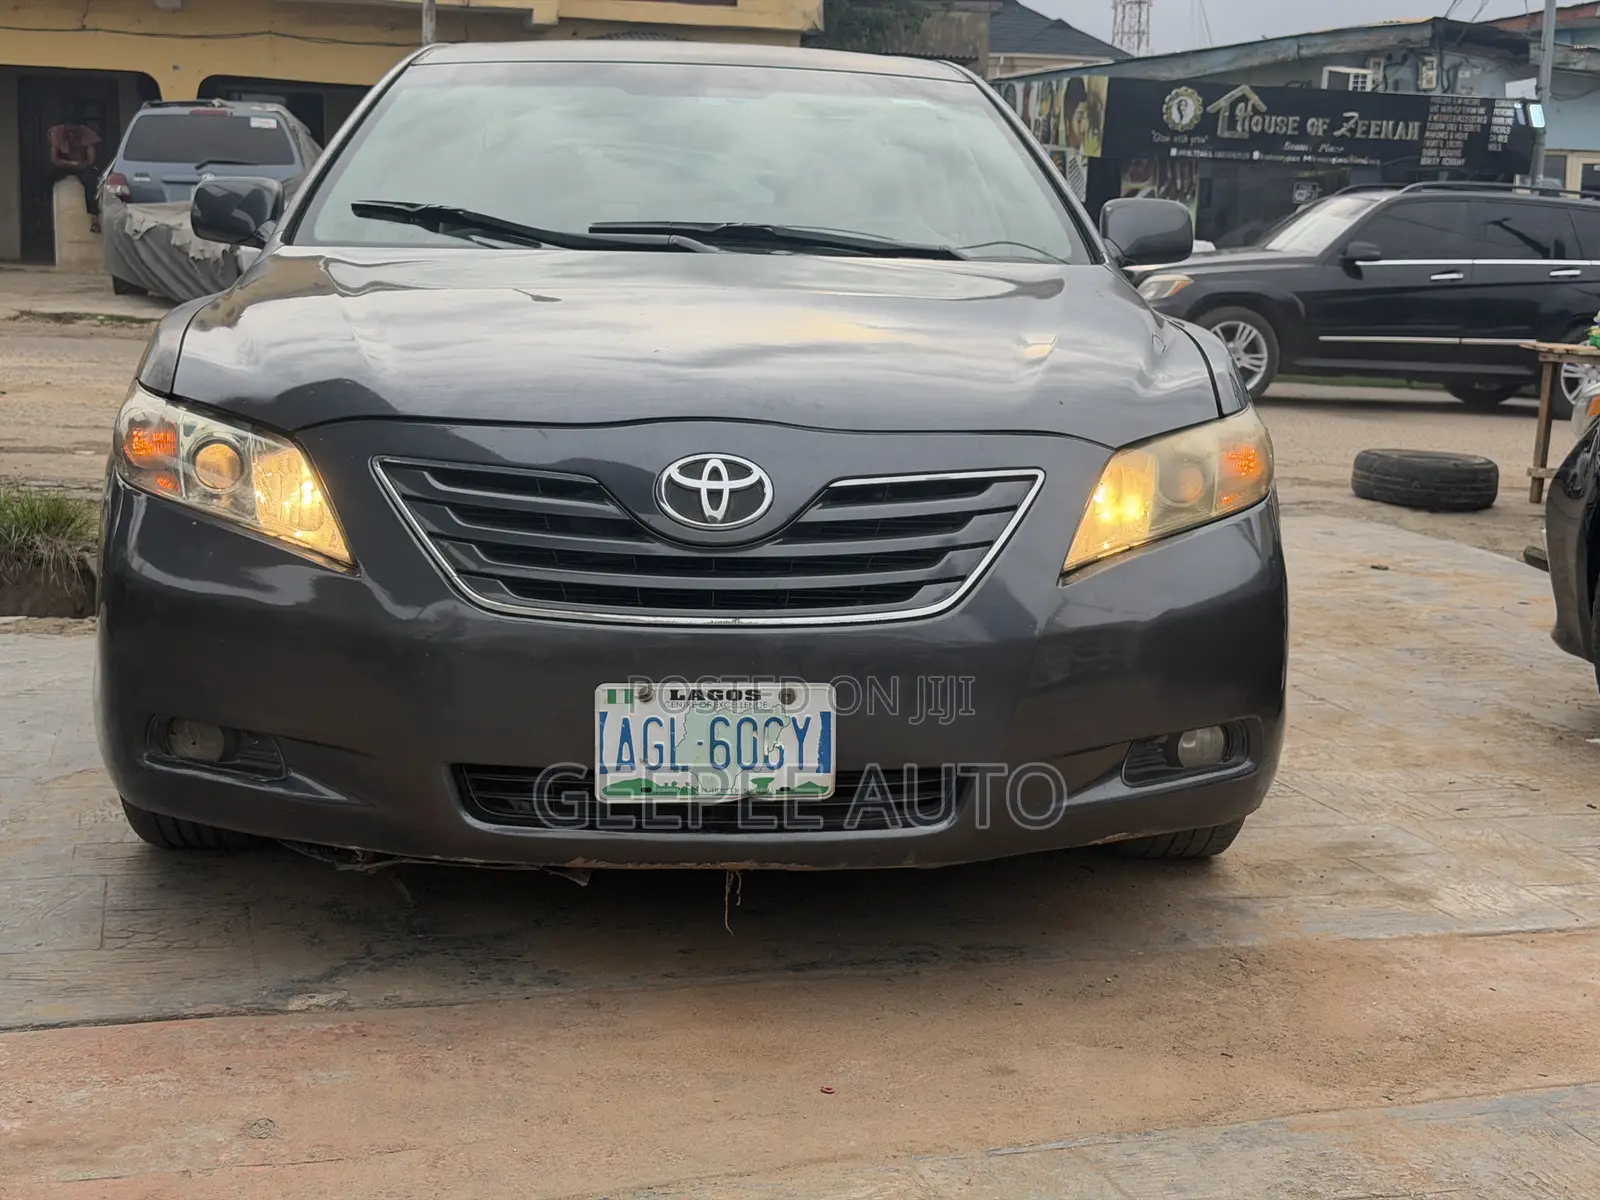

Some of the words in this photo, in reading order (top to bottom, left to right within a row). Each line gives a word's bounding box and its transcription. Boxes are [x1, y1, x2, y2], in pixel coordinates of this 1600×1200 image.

[1236, 102, 1300, 135] HOUSE
[1306, 117, 1330, 136] OF
[1333, 111, 1422, 141] ZEENAH
[669, 688, 762, 702] LAGOS
